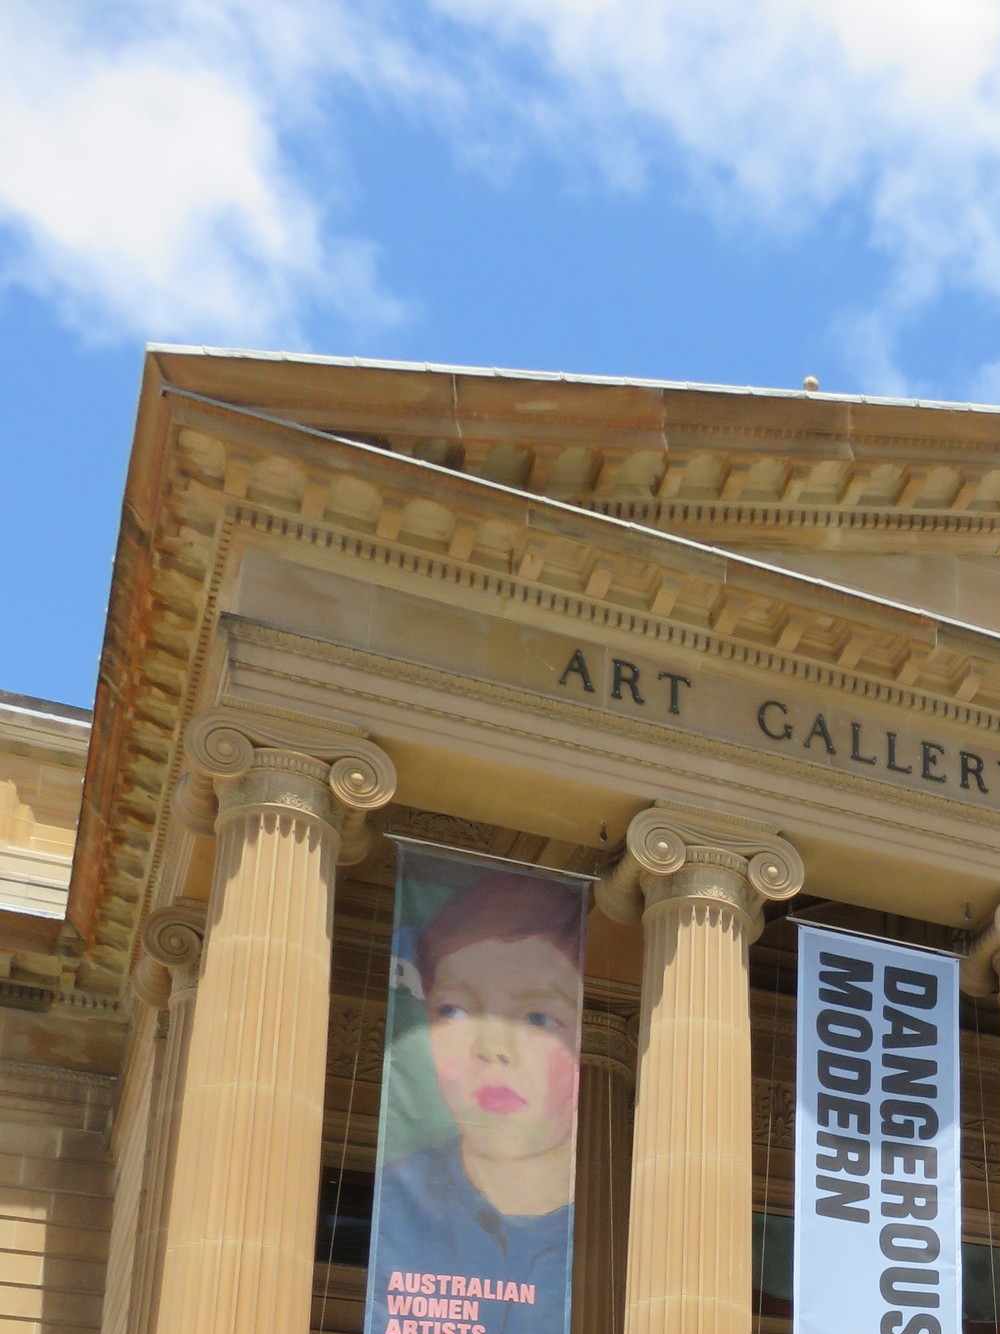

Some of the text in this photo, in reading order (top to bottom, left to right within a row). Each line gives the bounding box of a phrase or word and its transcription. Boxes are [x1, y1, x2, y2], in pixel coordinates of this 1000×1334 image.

[558, 649, 692, 715] ART
[816, 951, 875, 1224] MODERN
[387, 1271, 536, 1305] AUSTRALIAN
[387, 1295, 479, 1321] WOMEN
